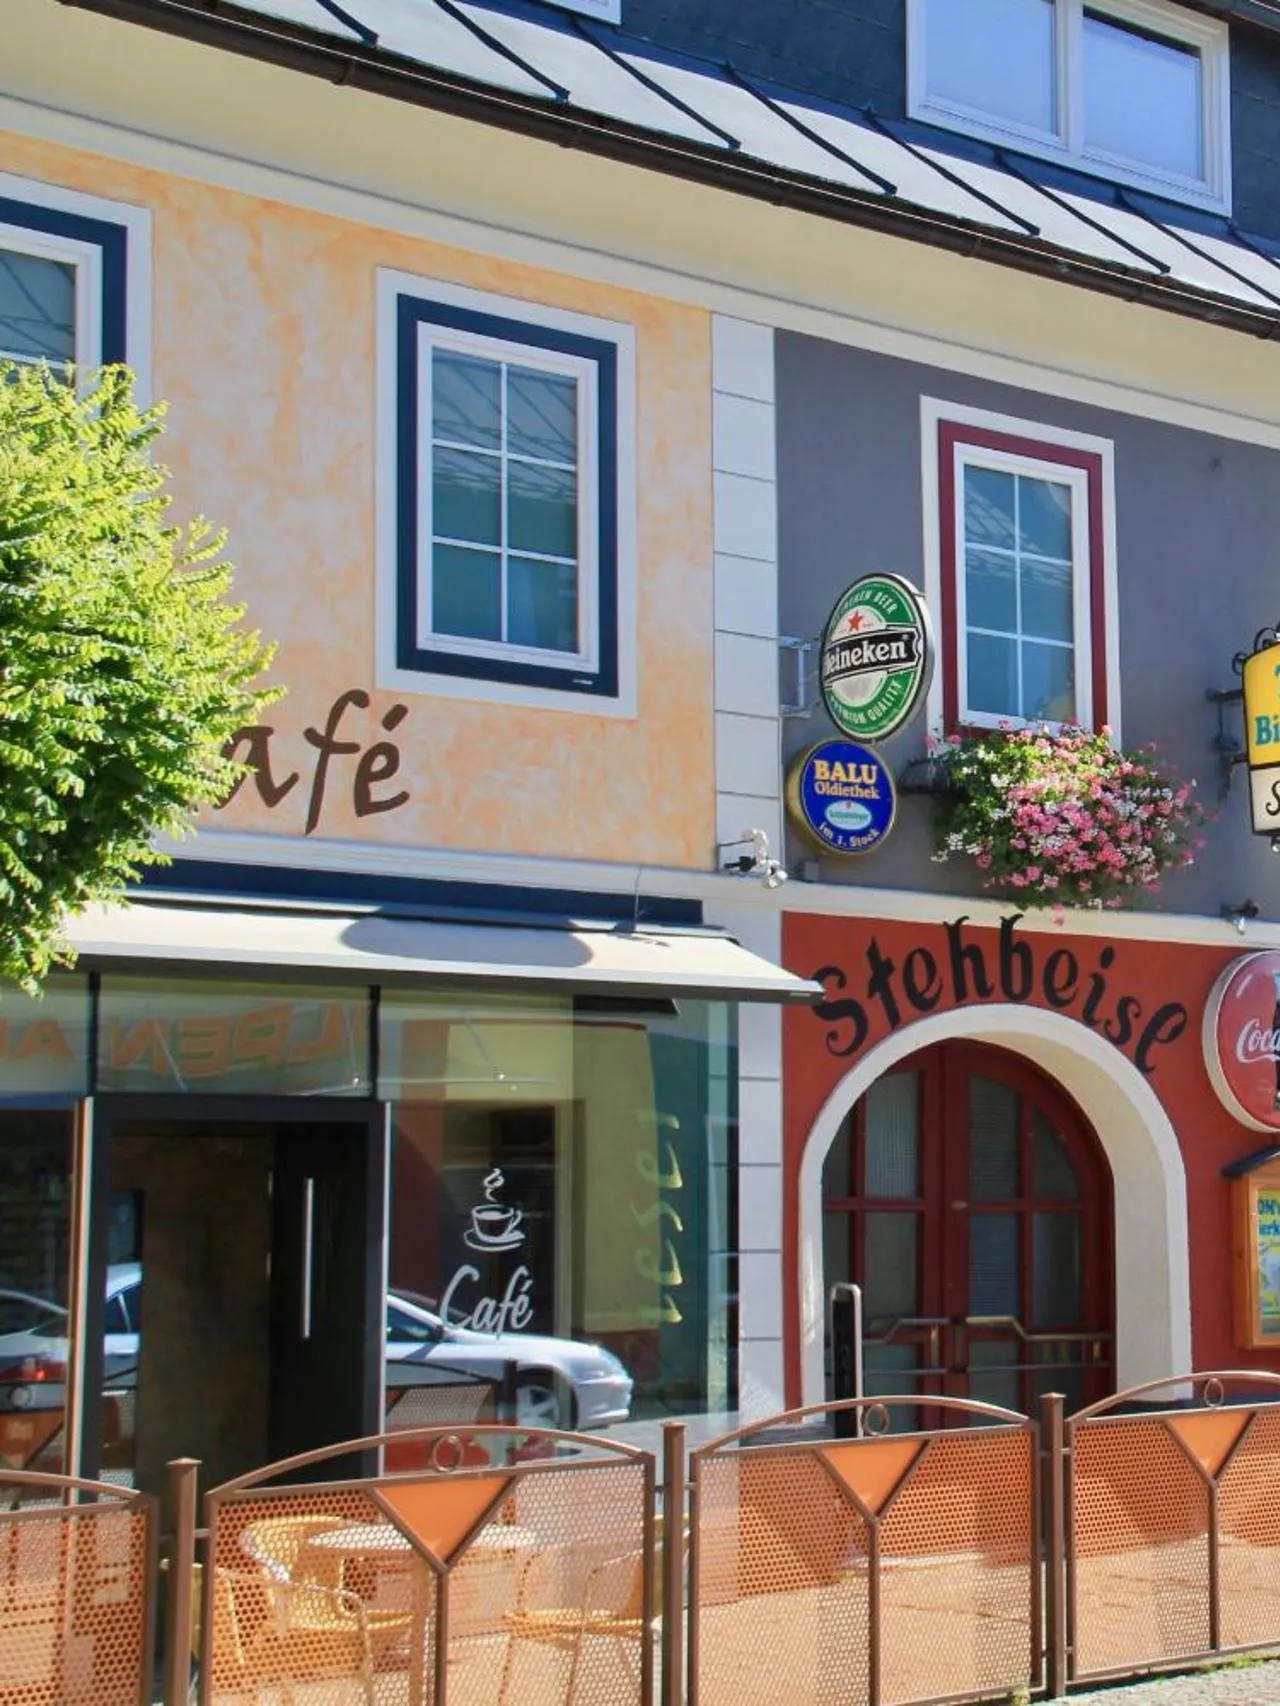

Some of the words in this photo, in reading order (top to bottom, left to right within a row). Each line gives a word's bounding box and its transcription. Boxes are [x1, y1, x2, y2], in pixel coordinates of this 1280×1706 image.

[874, 592, 899, 615] BEER
[868, 679, 902, 721] QUALITY
[212, 689, 411, 836] afé
[813, 760, 878, 785] BALU
[814, 781, 881, 799] Oldiethek
[849, 828, 880, 847] Stock
[810, 914, 1189, 1074] Stehbeisl
[439, 1264, 534, 1339] Café
